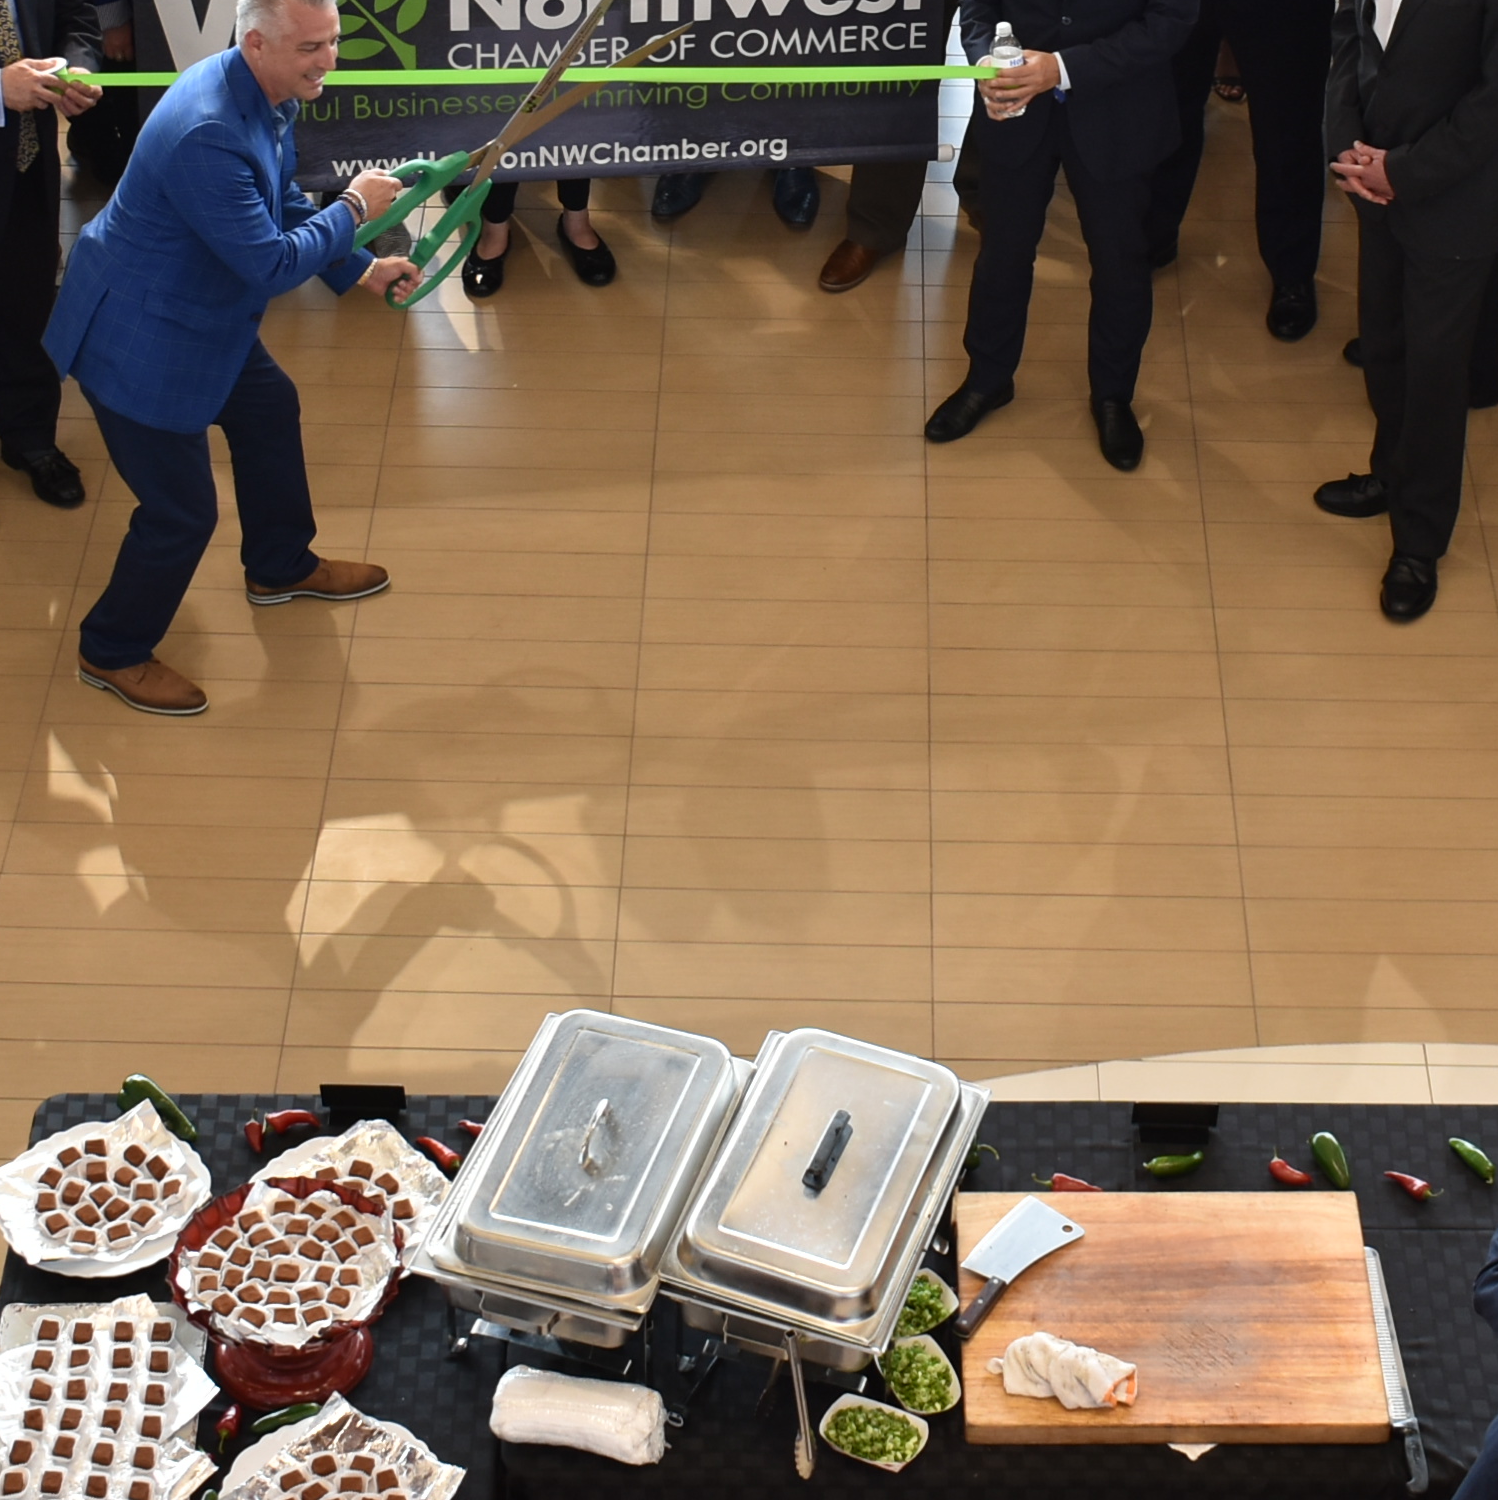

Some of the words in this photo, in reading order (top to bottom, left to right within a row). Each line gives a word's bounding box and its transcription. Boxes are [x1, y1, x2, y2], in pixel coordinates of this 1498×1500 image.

[645, 34, 696, 63] OF
[710, 22, 928, 58] COMMERCE
[580, 81, 708, 109] hriving
